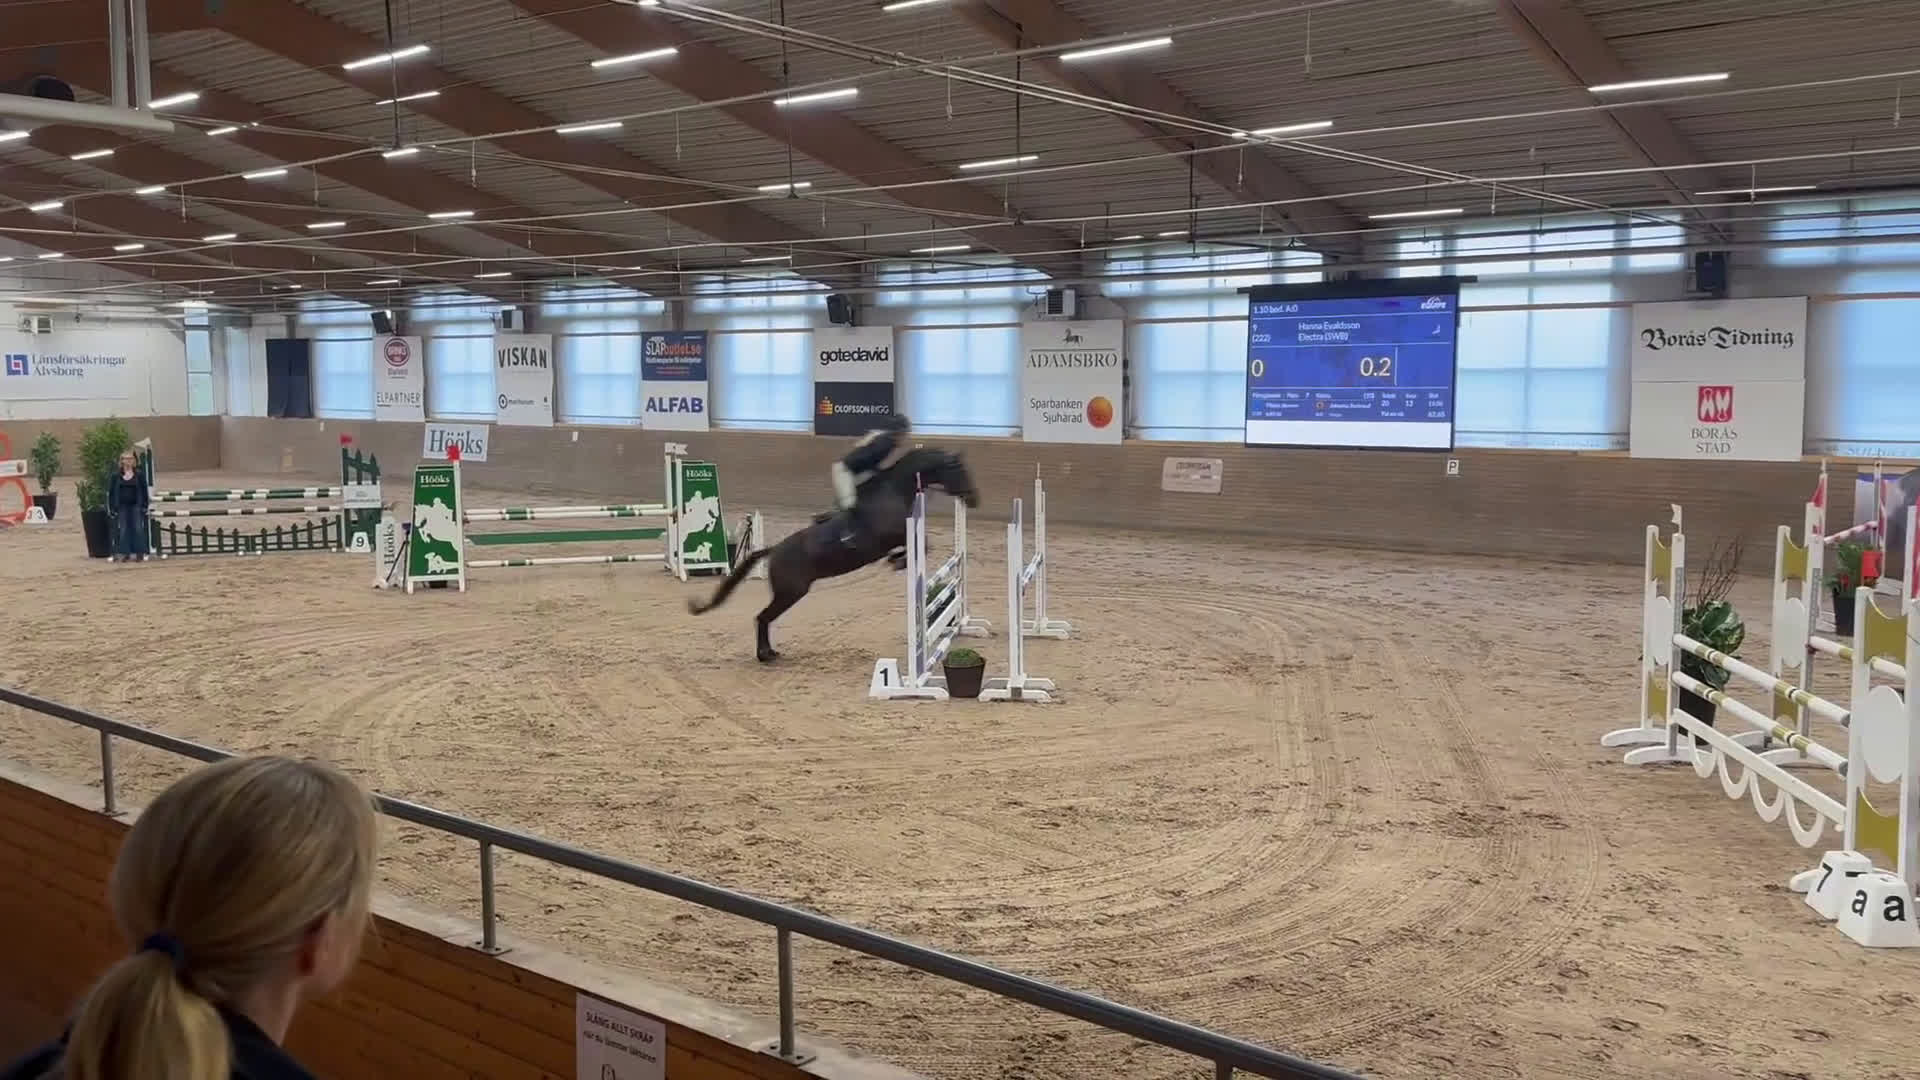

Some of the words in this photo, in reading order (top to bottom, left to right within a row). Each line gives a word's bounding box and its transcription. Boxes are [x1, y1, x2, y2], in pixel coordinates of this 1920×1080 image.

[1641, 328, 1706, 350] Borås
[1707, 326, 1794, 349] Tidning
[498, 346, 548, 368] VISKAN
[1027, 352, 1118, 368] ADAMSBRO
[1251, 359, 1264, 377] 0
[1360, 357, 1391, 377] 0.2
[376, 391, 421, 404] ELPARTNER
[645, 396, 703, 413] ALFAB
[1030, 397, 1083, 411] Sparbanken
[834, 404, 870, 414] OLOFSSON
[870, 404, 889, 414] BYGG
[1691, 425, 1738, 440] BORÅS
[430, 430, 484, 454] Hööks
[1695, 441, 1732, 454] STAD
[420, 475, 450, 484] Hööks
[356, 536, 365, 548] 9
[879, 667, 889, 687] 1
[1816, 862, 1833, 893] 7
[1851, 888, 1868, 918] a
[1883, 895, 1906, 922] a
